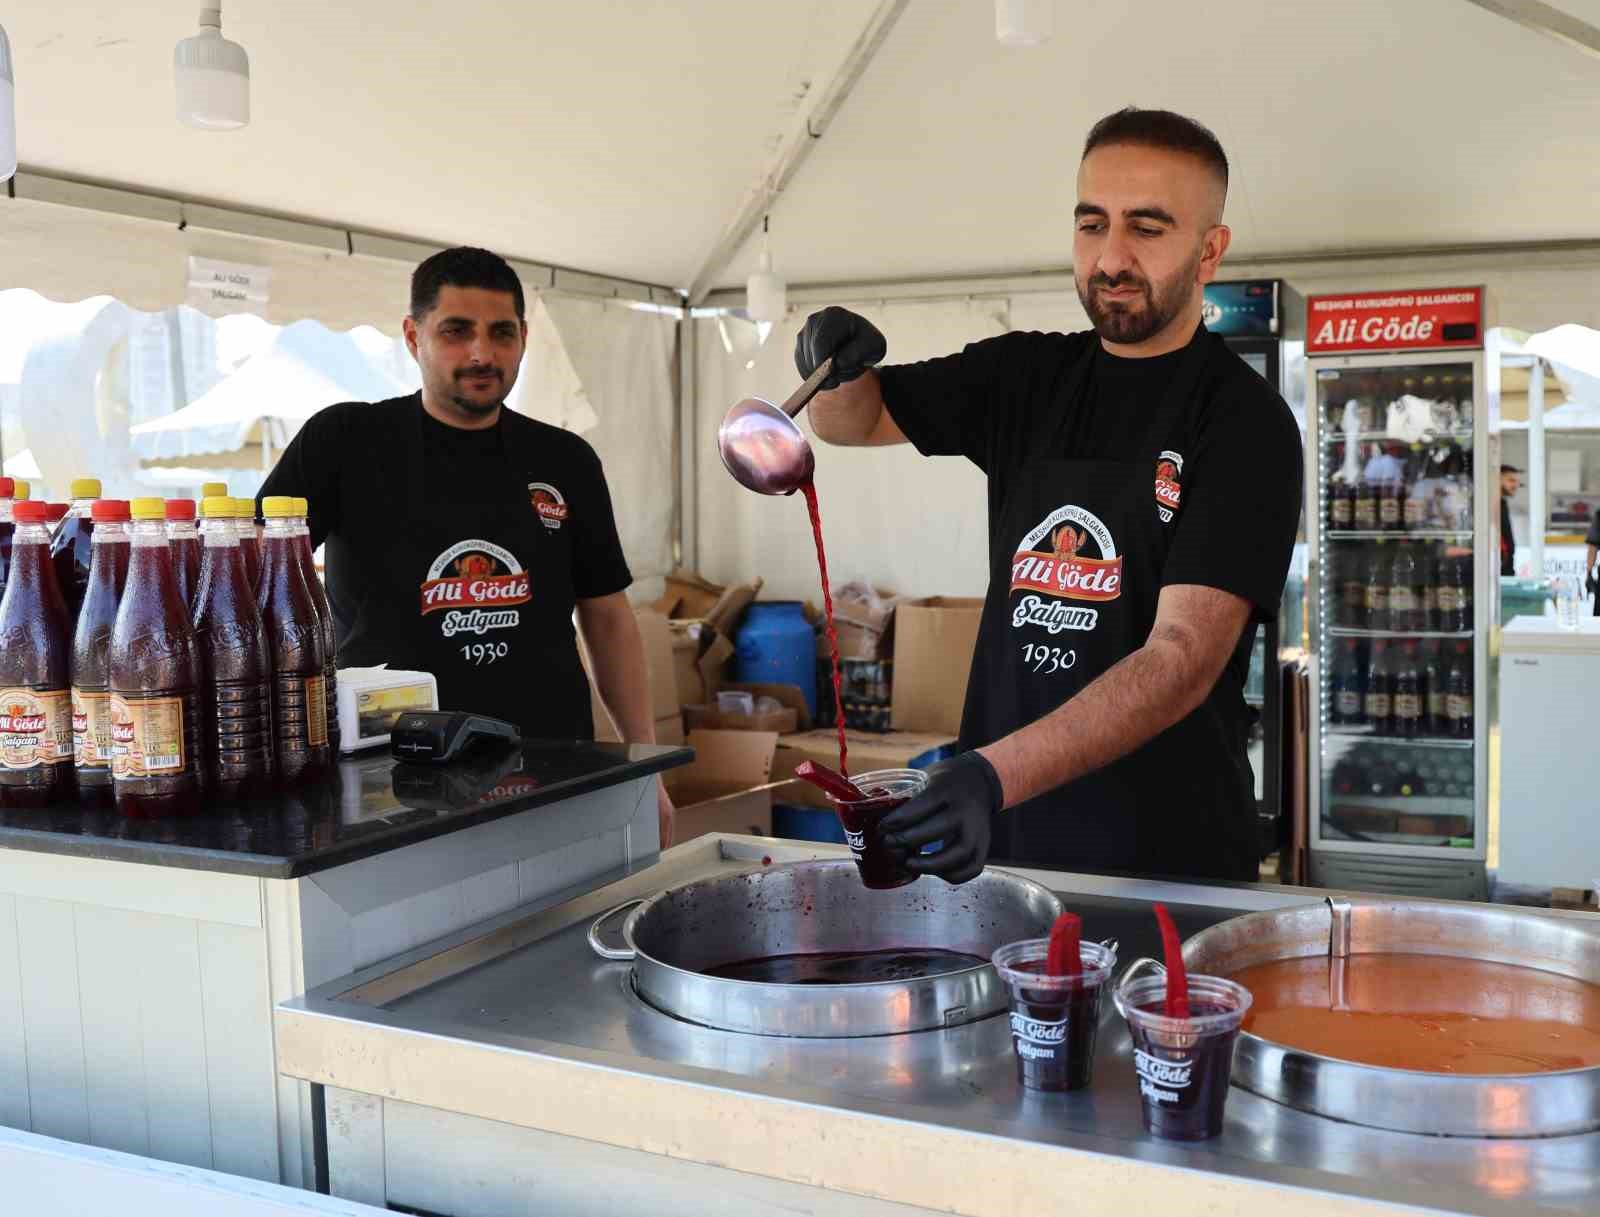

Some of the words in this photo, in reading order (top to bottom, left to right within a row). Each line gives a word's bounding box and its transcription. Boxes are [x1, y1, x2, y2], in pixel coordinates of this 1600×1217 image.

[1314, 318, 1358, 345] Ali
[1361, 315, 1434, 343] Göde
[1013, 556, 1053, 584] Ali
[1056, 562, 1120, 593] Göde
[424, 582, 463, 605] Ali
[469, 580, 529, 602] Göde
[460, 642, 508, 665] 1930
[1022, 643, 1077, 674] 1930
